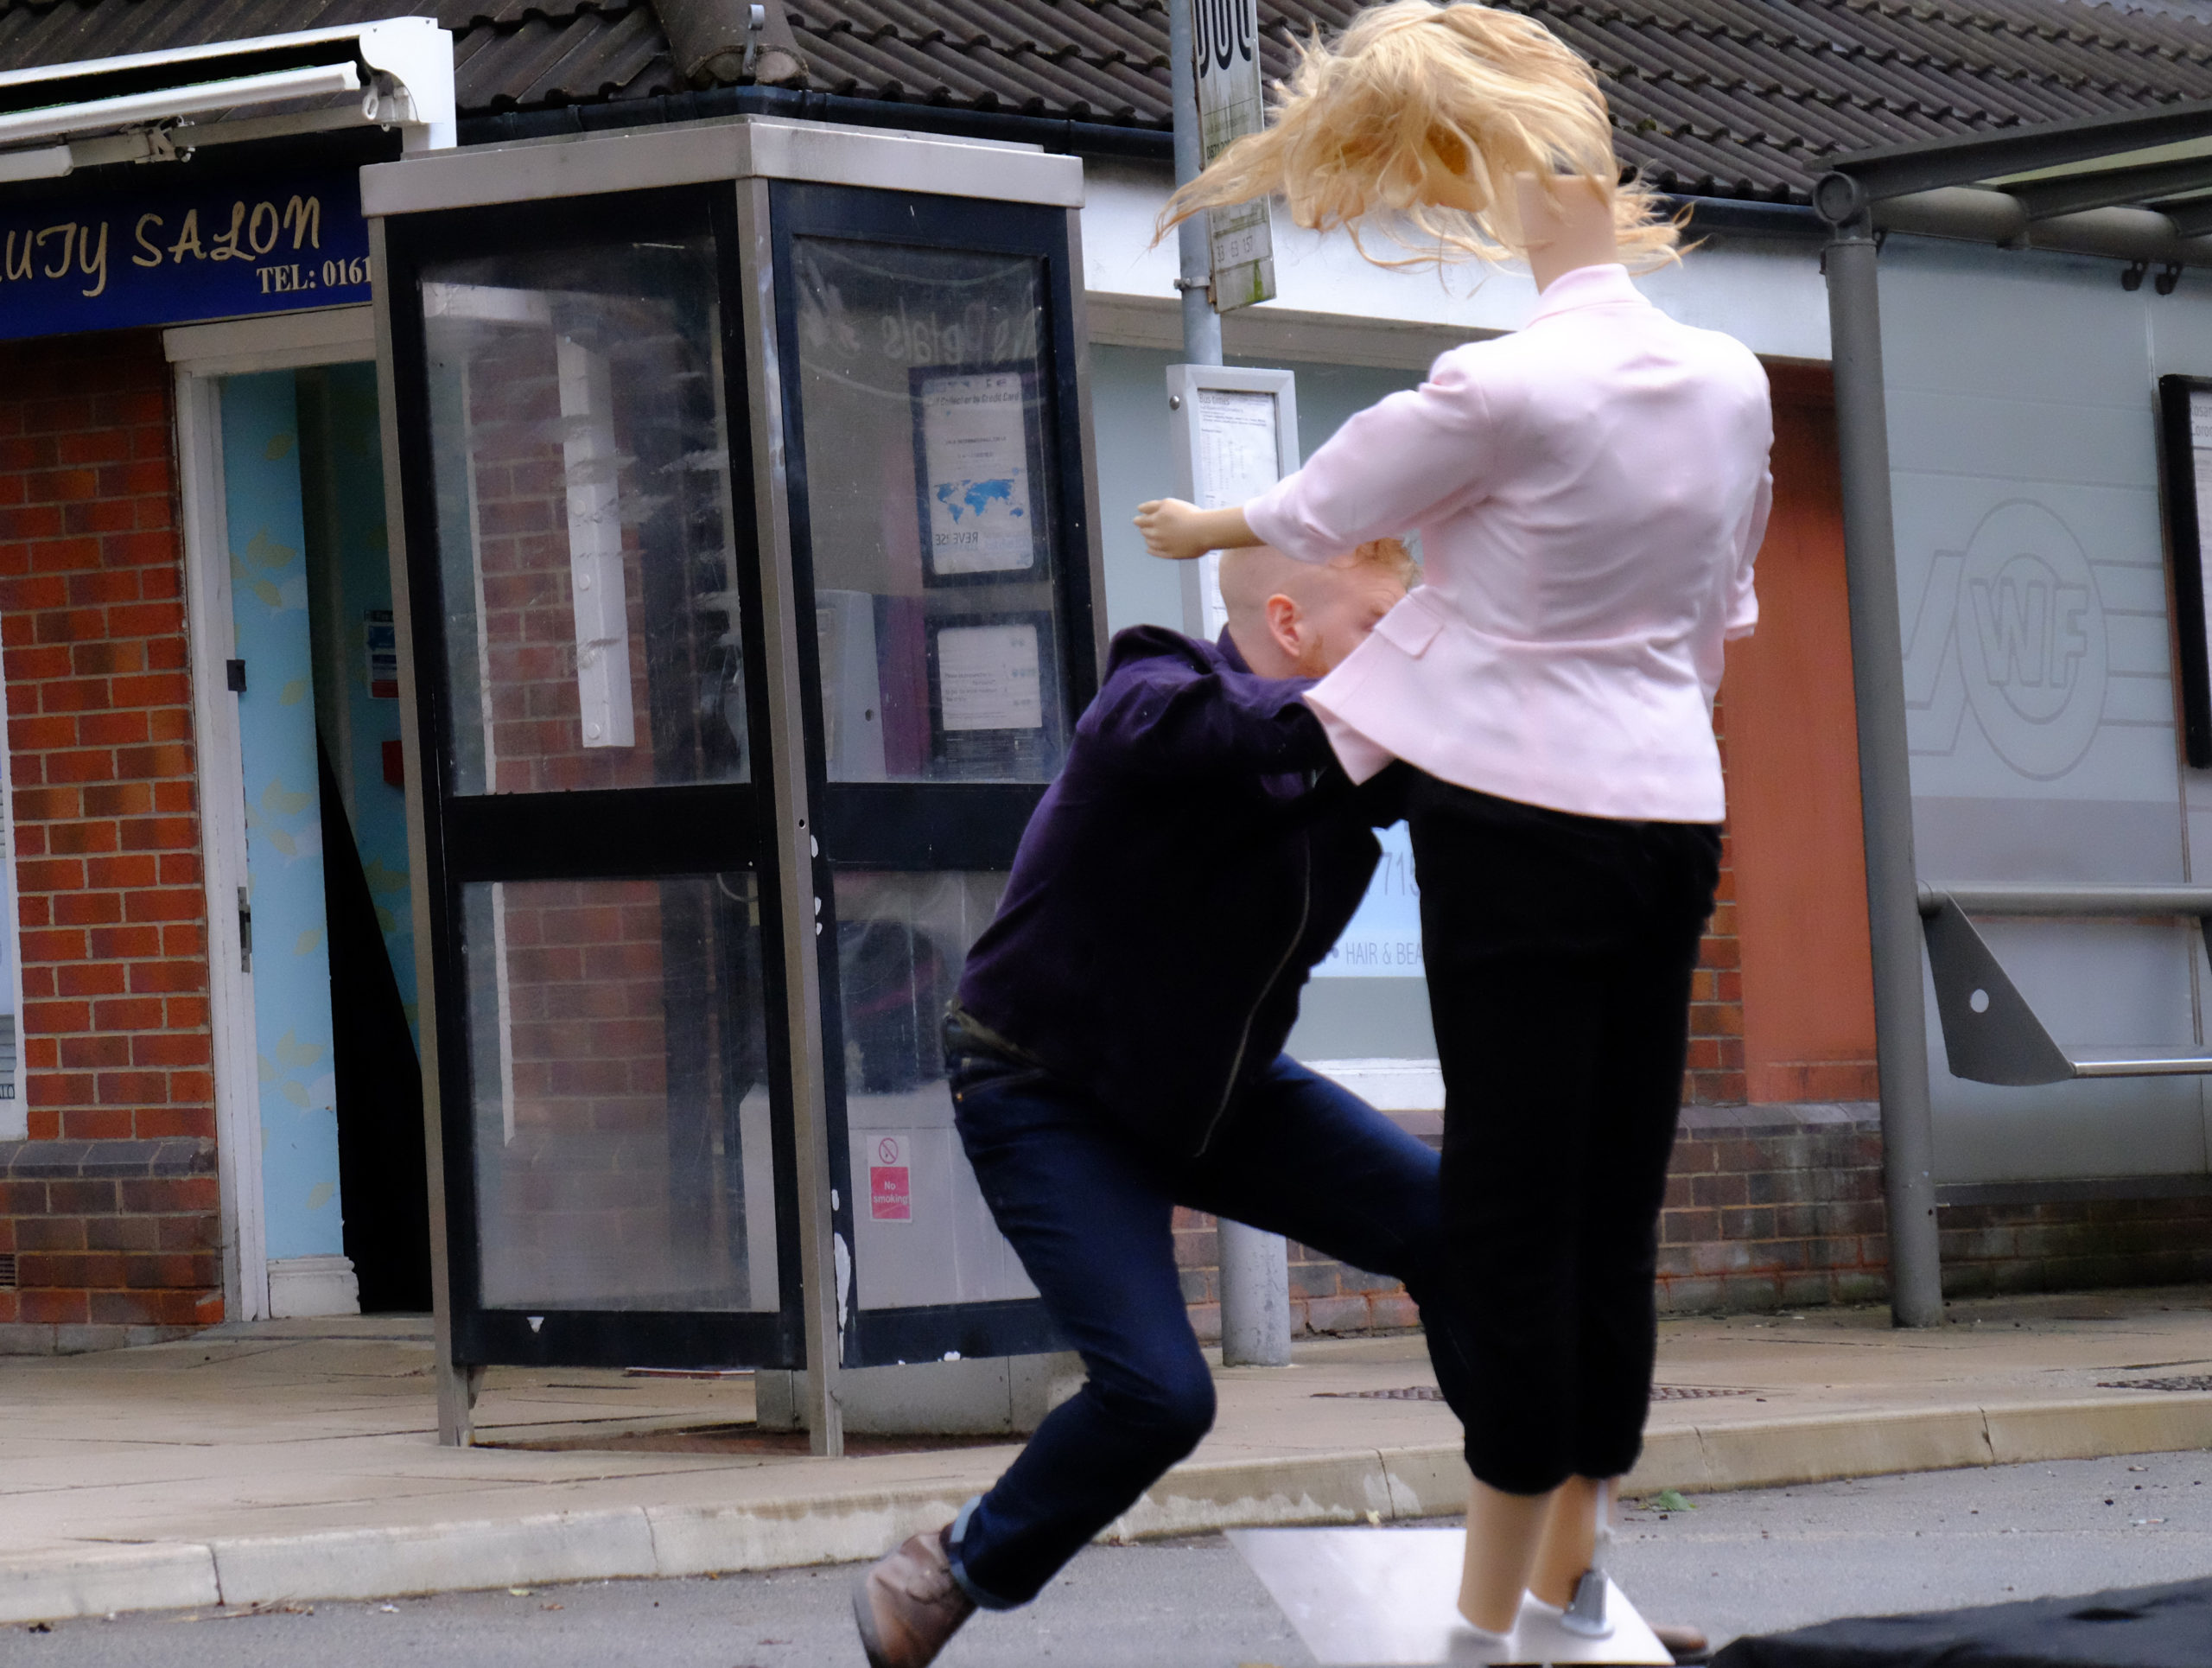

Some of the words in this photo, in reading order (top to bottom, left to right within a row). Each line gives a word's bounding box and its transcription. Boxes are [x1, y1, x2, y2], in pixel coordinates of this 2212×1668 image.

[131, 194, 321, 267] SALON
[256, 264, 317, 294] TEL:
[322, 257, 372, 287] 0161
[1345, 941, 1378, 965] HAIR
[1382, 942, 1392, 965] &
[884, 1181, 896, 1191] No
[874, 1194, 908, 1205] smoking
